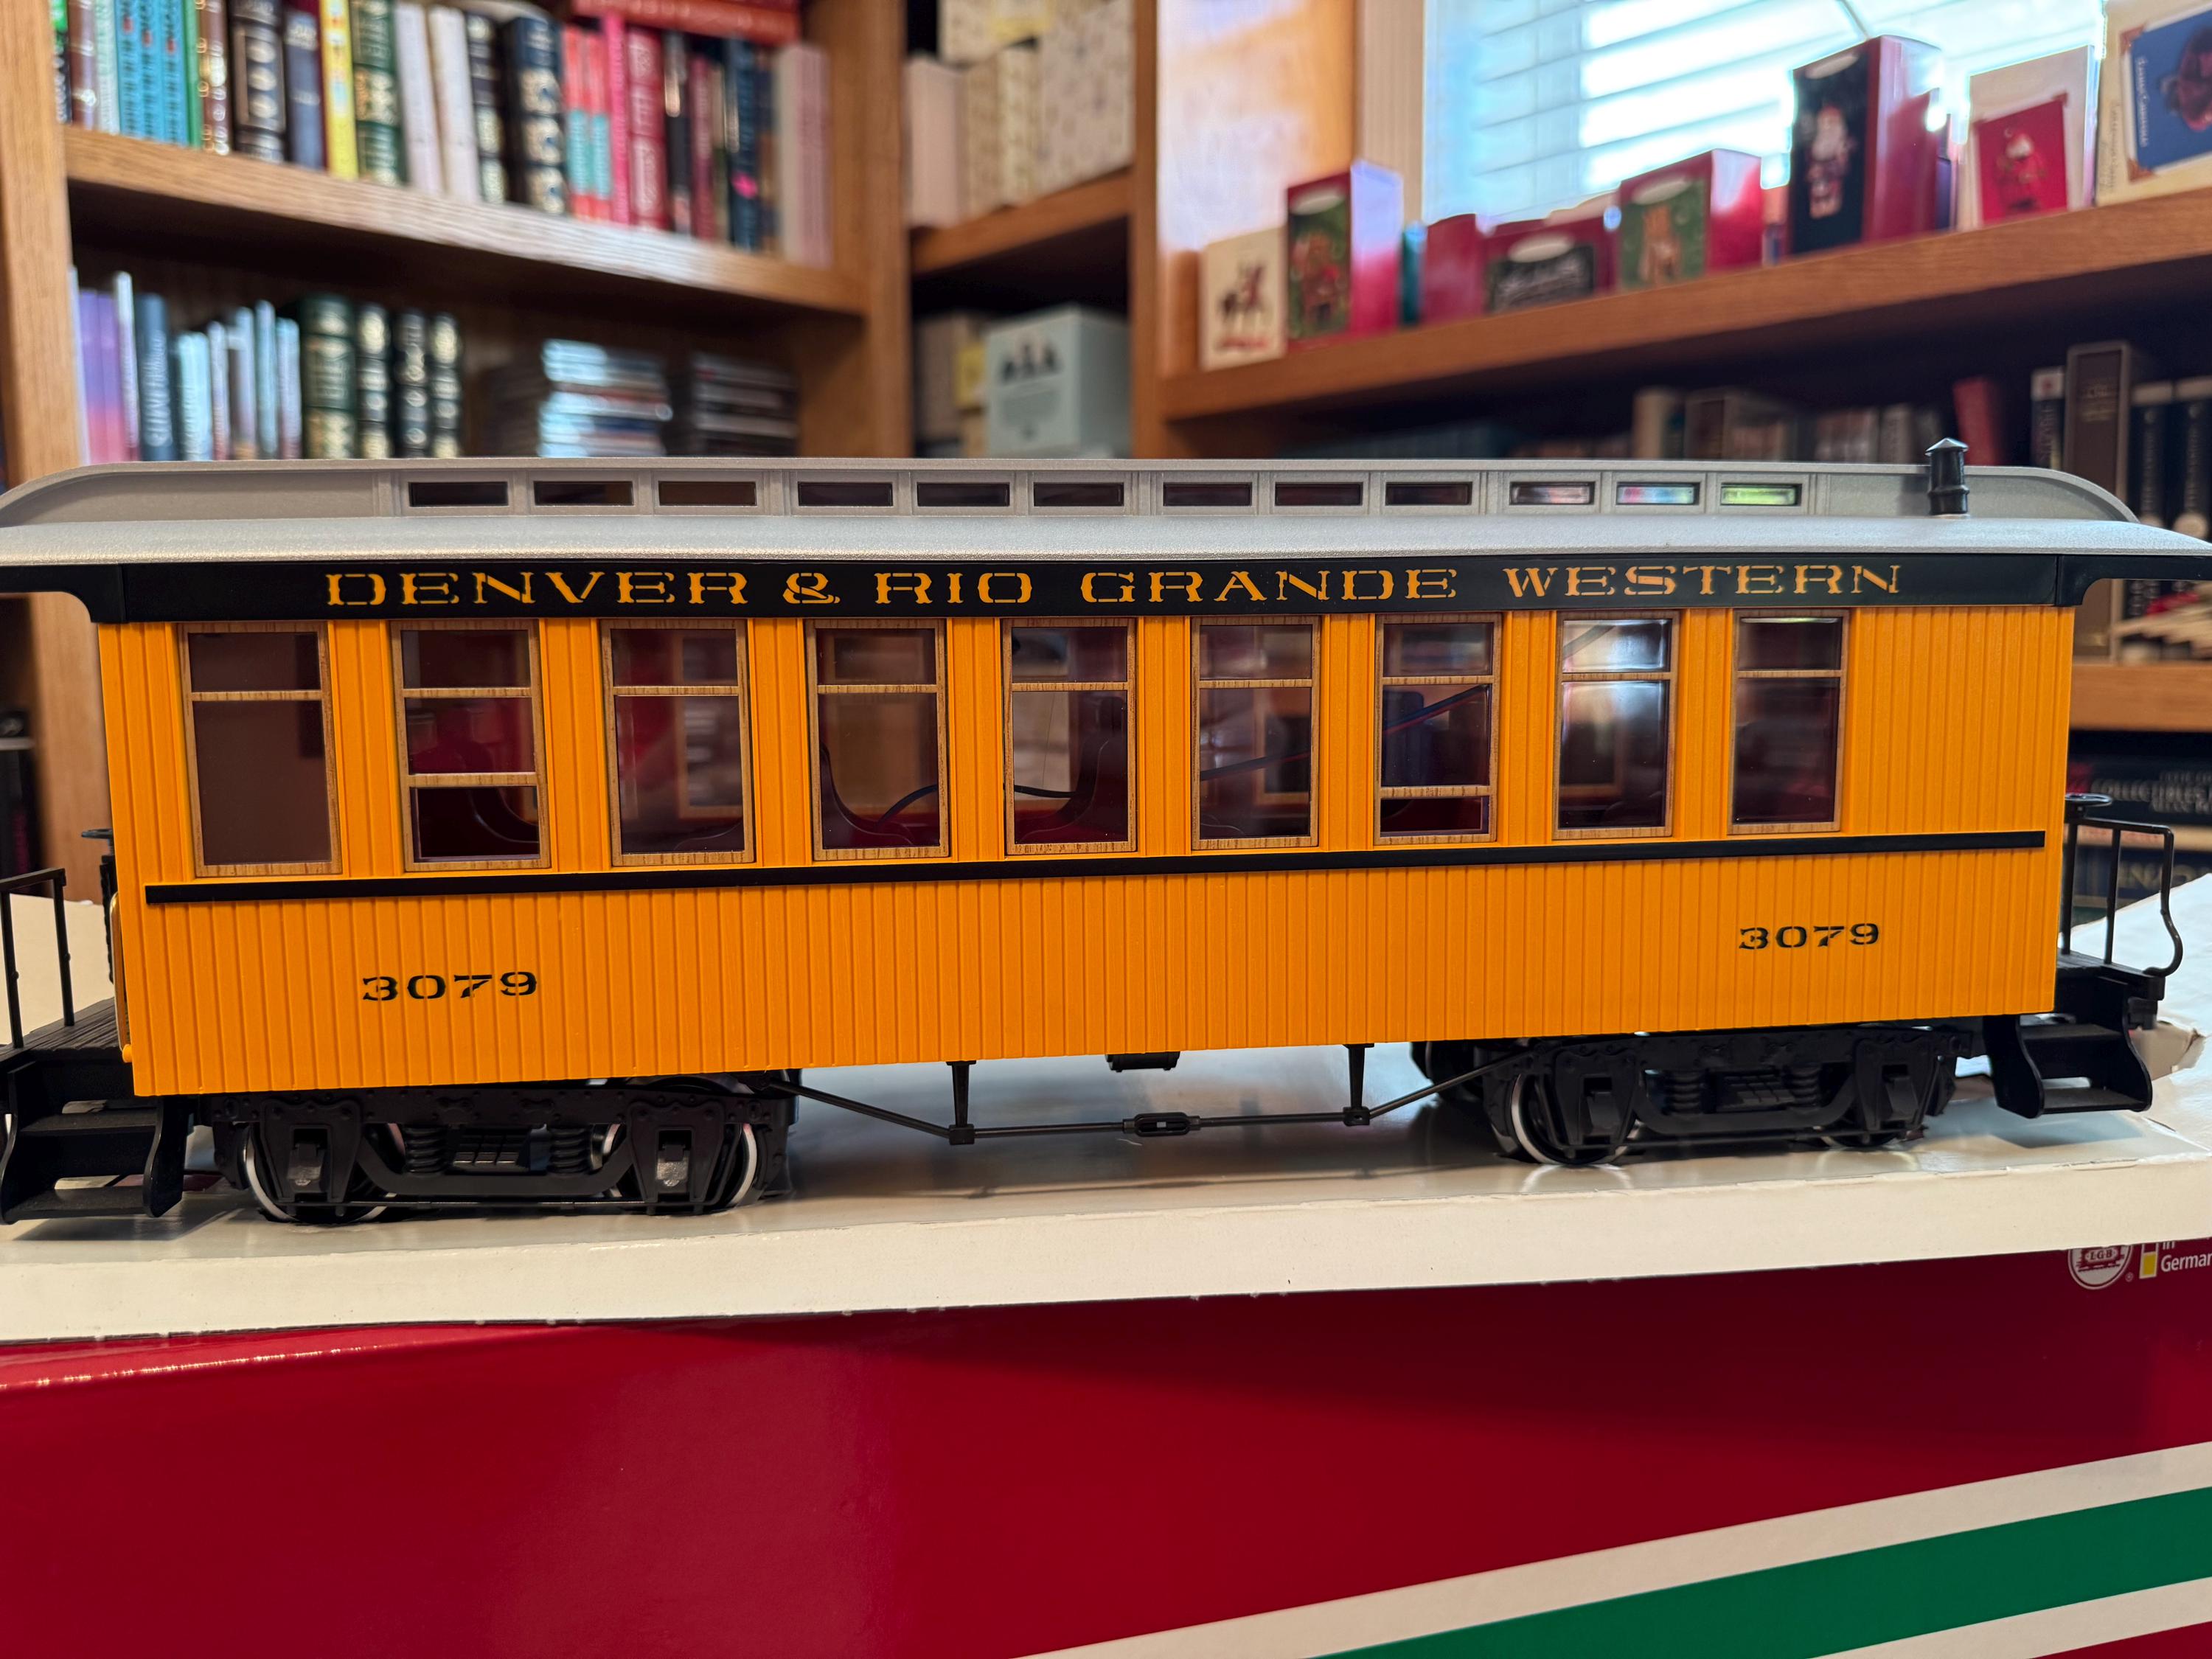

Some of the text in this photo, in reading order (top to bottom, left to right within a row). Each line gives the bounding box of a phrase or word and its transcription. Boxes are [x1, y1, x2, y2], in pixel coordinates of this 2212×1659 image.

[326, 566, 1900, 605] DENVER & RIO GRANDE WESTERN
[1739, 923, 1879, 950] 3079
[362, 971, 538, 1001] 3079
[2090, 1248, 2113, 1260] LGB
